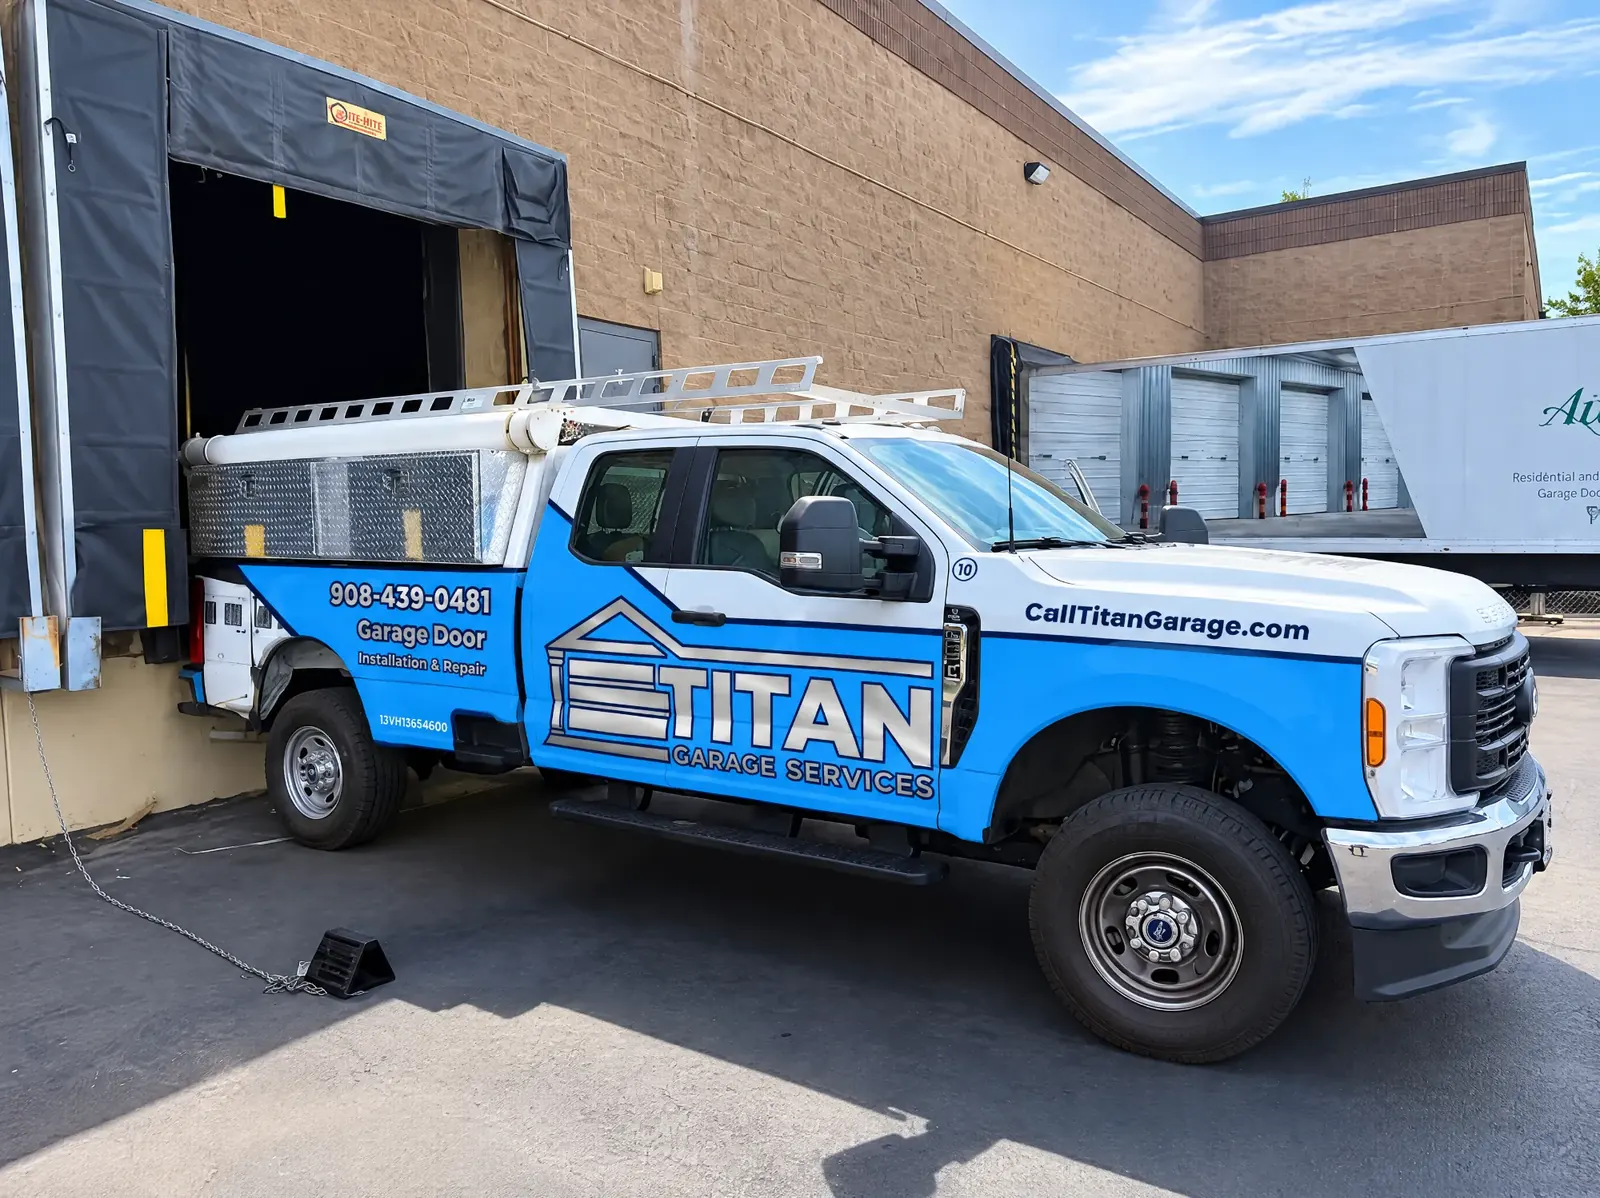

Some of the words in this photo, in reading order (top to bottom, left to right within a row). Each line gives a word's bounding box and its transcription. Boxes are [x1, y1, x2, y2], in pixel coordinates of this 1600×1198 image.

[1539, 387, 1600, 436] Ai
[1512, 471, 1575, 483] Residential
[1578, 471, 1599, 482] and
[1537, 488, 1578, 501] Garage
[958, 563, 973, 577] 10
[329, 580, 492, 615] 908-439-0481
[357, 618, 429, 649] Garage
[432, 623, 487, 650] Door
[1025, 603, 1310, 641] CallTitanGarage.com
[358, 651, 428, 671] Installation
[430, 658, 440, 672] &
[443, 659, 487, 677] Repair
[379, 714, 448, 733] 13VH13654600
[658, 664, 934, 770] TITAN
[671, 744, 777, 778] GARAGE
[784, 757, 935, 799] SERVICES
